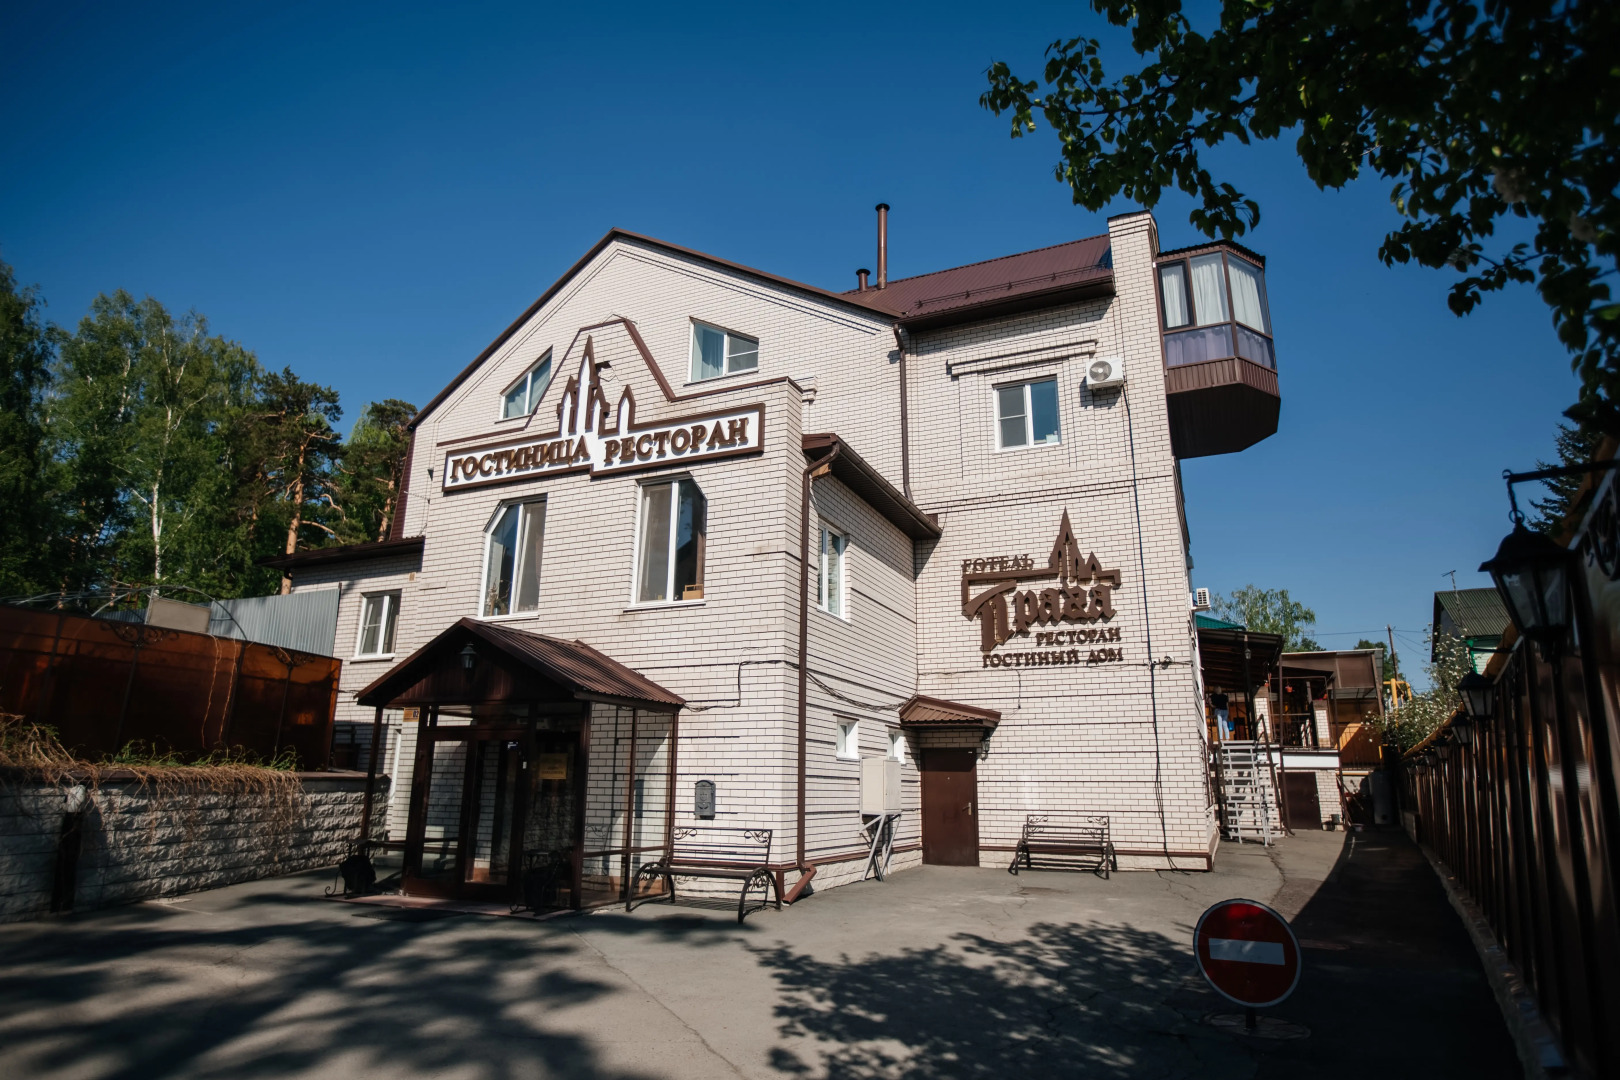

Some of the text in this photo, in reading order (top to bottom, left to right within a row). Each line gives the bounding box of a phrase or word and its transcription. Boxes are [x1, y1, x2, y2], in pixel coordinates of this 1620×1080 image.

[450, 417, 749, 480] ГОСТИНИЦА РЕСТОРАН
[1036, 628, 1121, 646] РЕСТОРАН
[983, 648, 1123, 668] ГОСТИНЫЙ ДОМ
